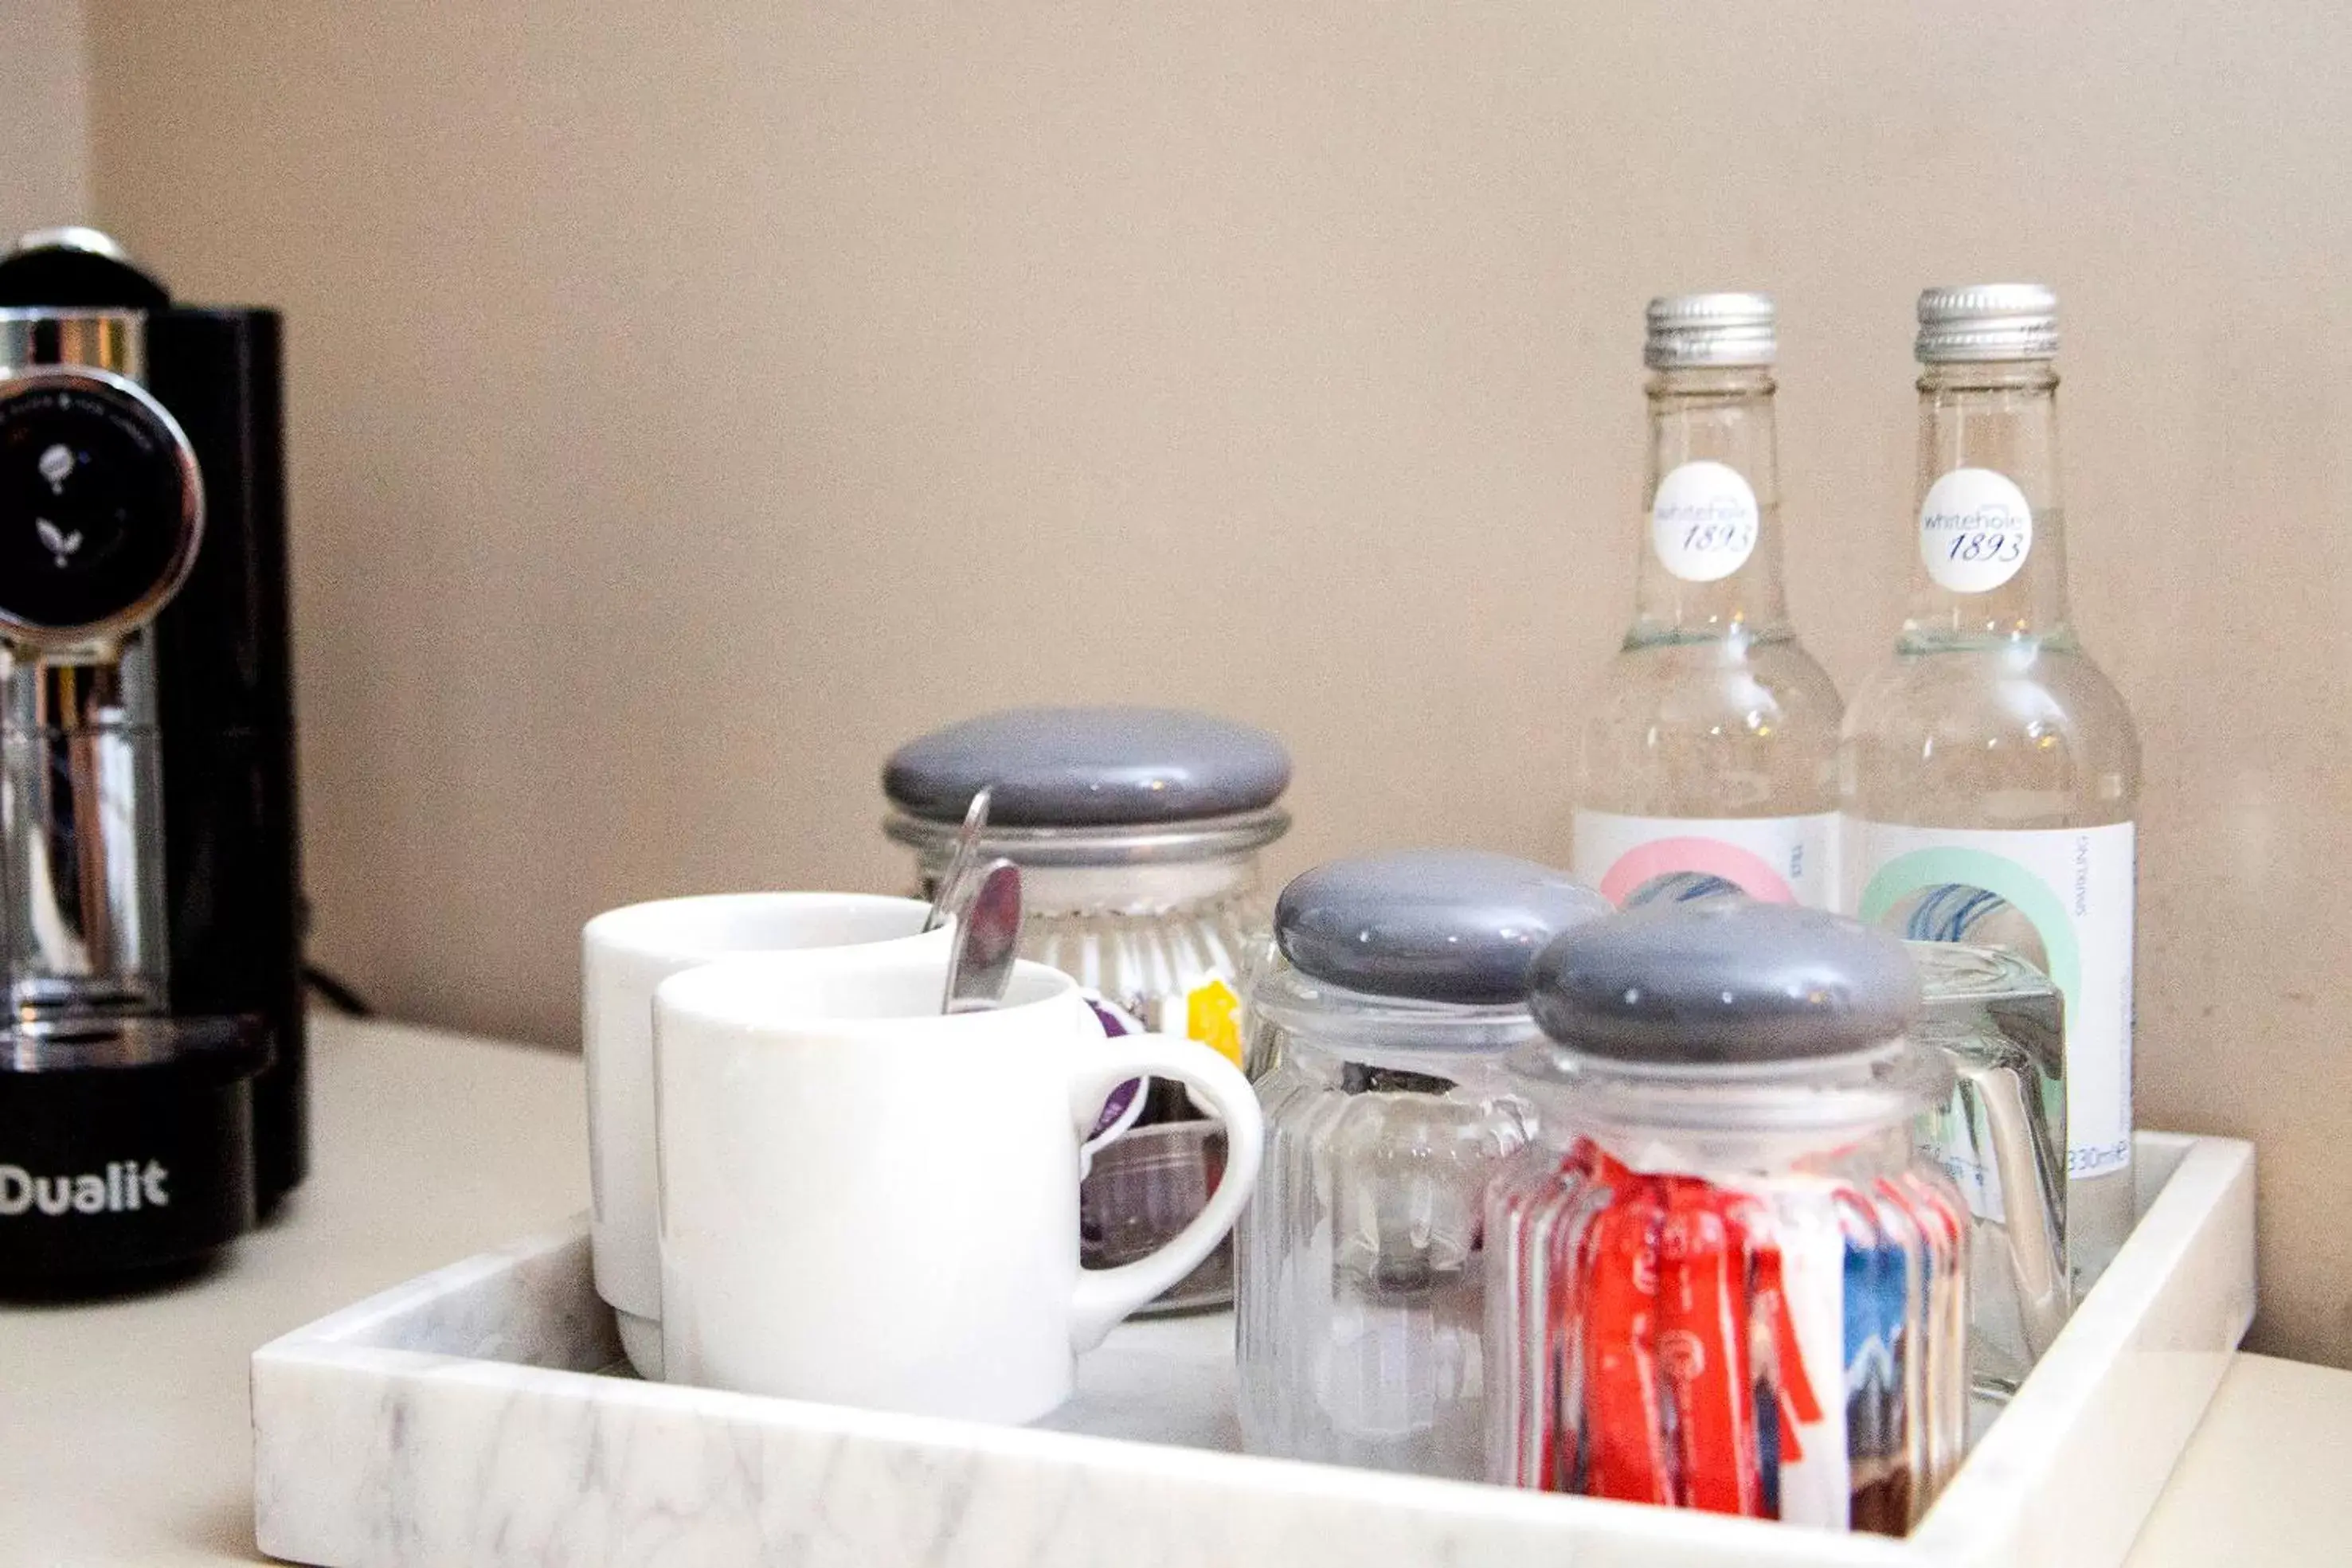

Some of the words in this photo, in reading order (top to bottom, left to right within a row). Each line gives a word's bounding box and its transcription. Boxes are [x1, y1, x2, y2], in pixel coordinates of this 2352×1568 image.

[1683, 524, 1755, 553] 1893
[1949, 532, 2024, 562] 1893
[0, 1158, 170, 1216] Dualit
